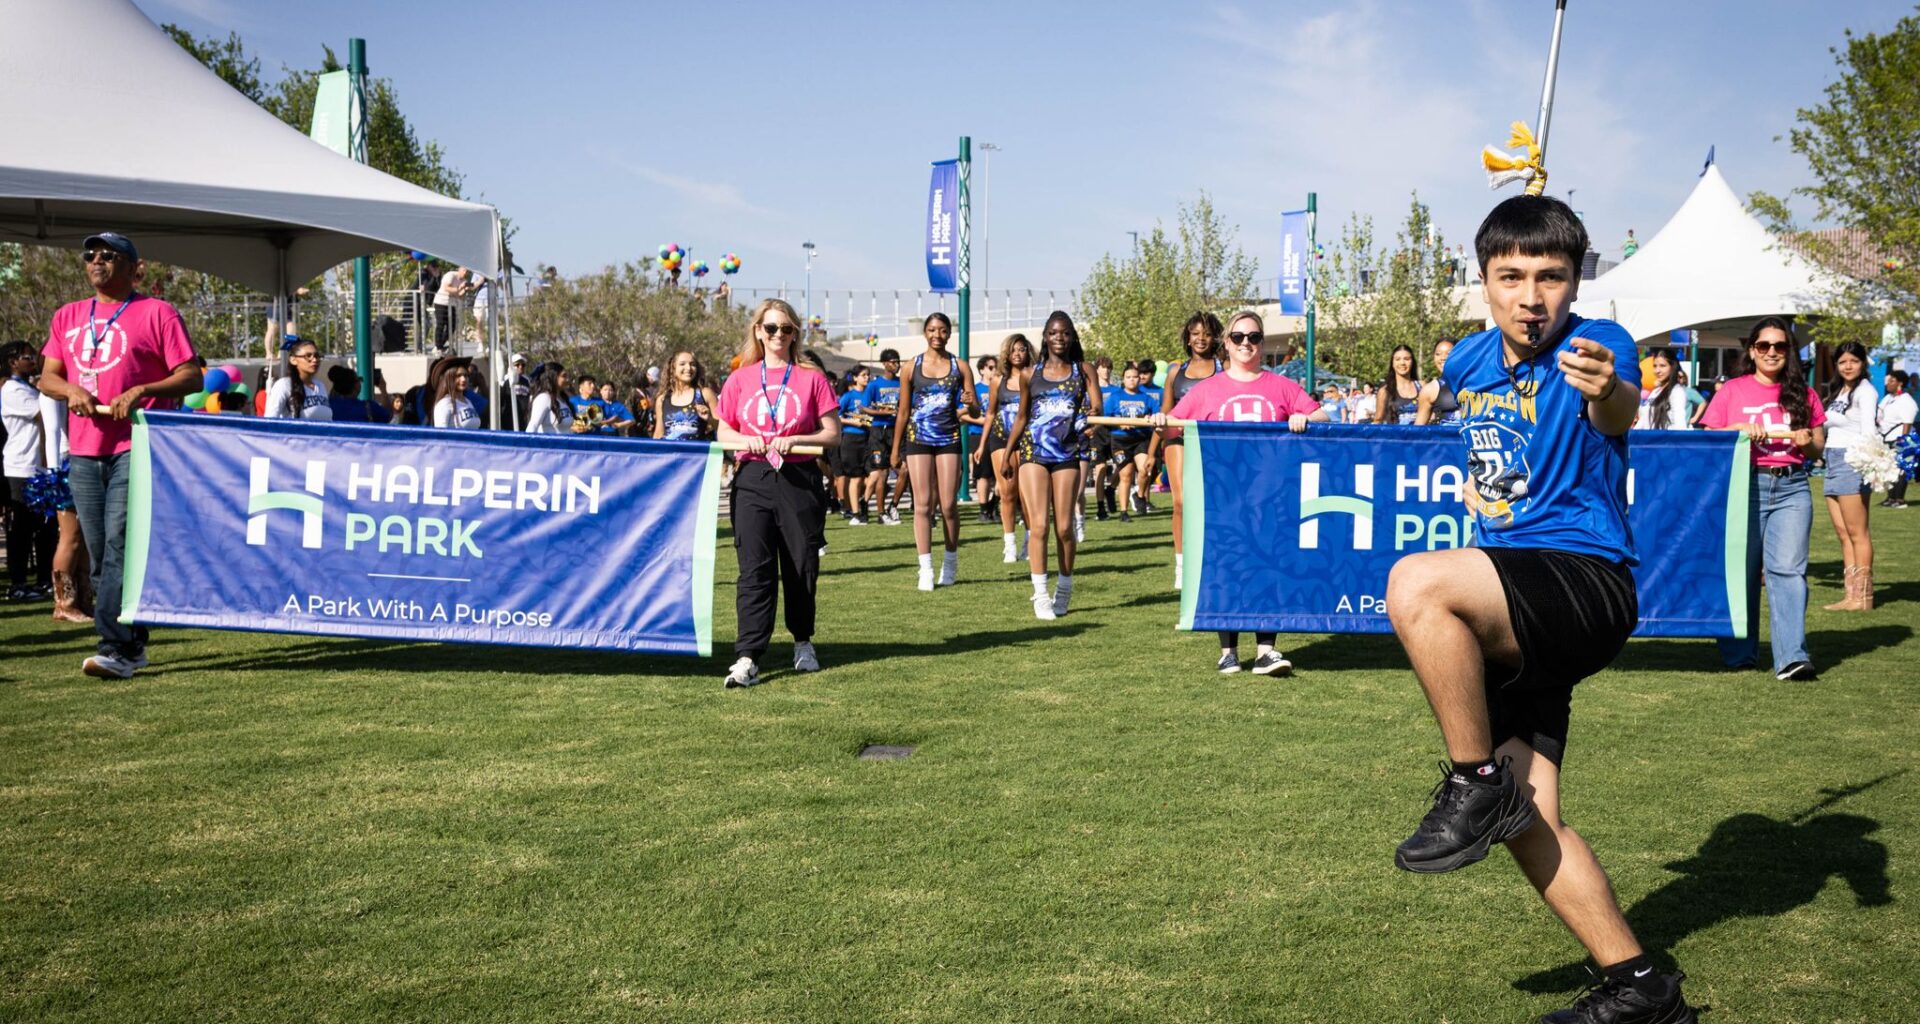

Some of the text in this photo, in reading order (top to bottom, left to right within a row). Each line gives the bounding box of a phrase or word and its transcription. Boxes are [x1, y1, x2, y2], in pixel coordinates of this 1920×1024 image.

[1470, 428, 1502, 449] BIG
[347, 462, 601, 514] HALPERIN
[345, 512, 483, 558] PARK
[283, 594, 552, 629] A Park With A Purpose
[1335, 594, 1387, 614] A Pa
